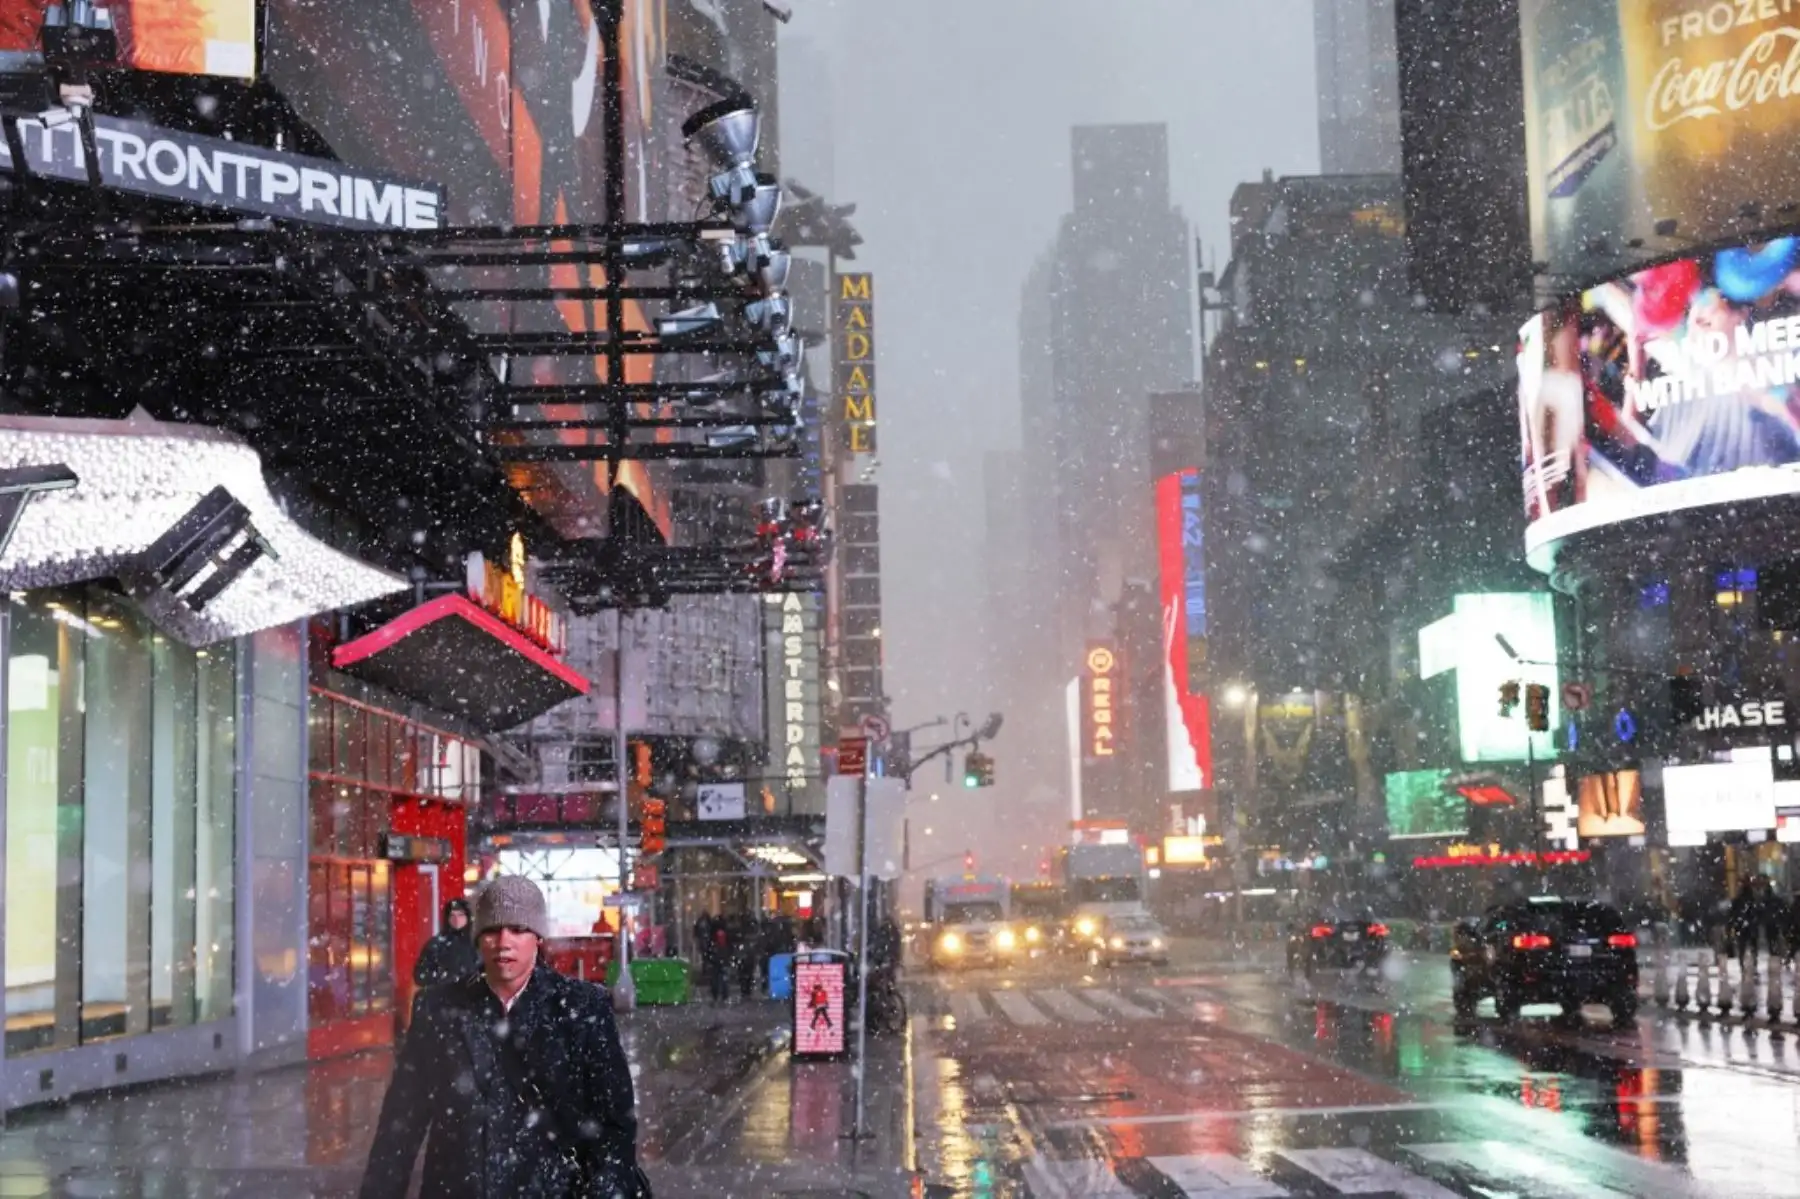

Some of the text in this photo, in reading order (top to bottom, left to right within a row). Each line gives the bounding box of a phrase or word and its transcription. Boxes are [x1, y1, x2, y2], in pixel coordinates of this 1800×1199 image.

[841, 274, 873, 452] MADAME
[1632, 362, 1706, 411] WITH
[783, 592, 807, 788] AMSTERDAM
[1093, 677, 1113, 755] REGAL
